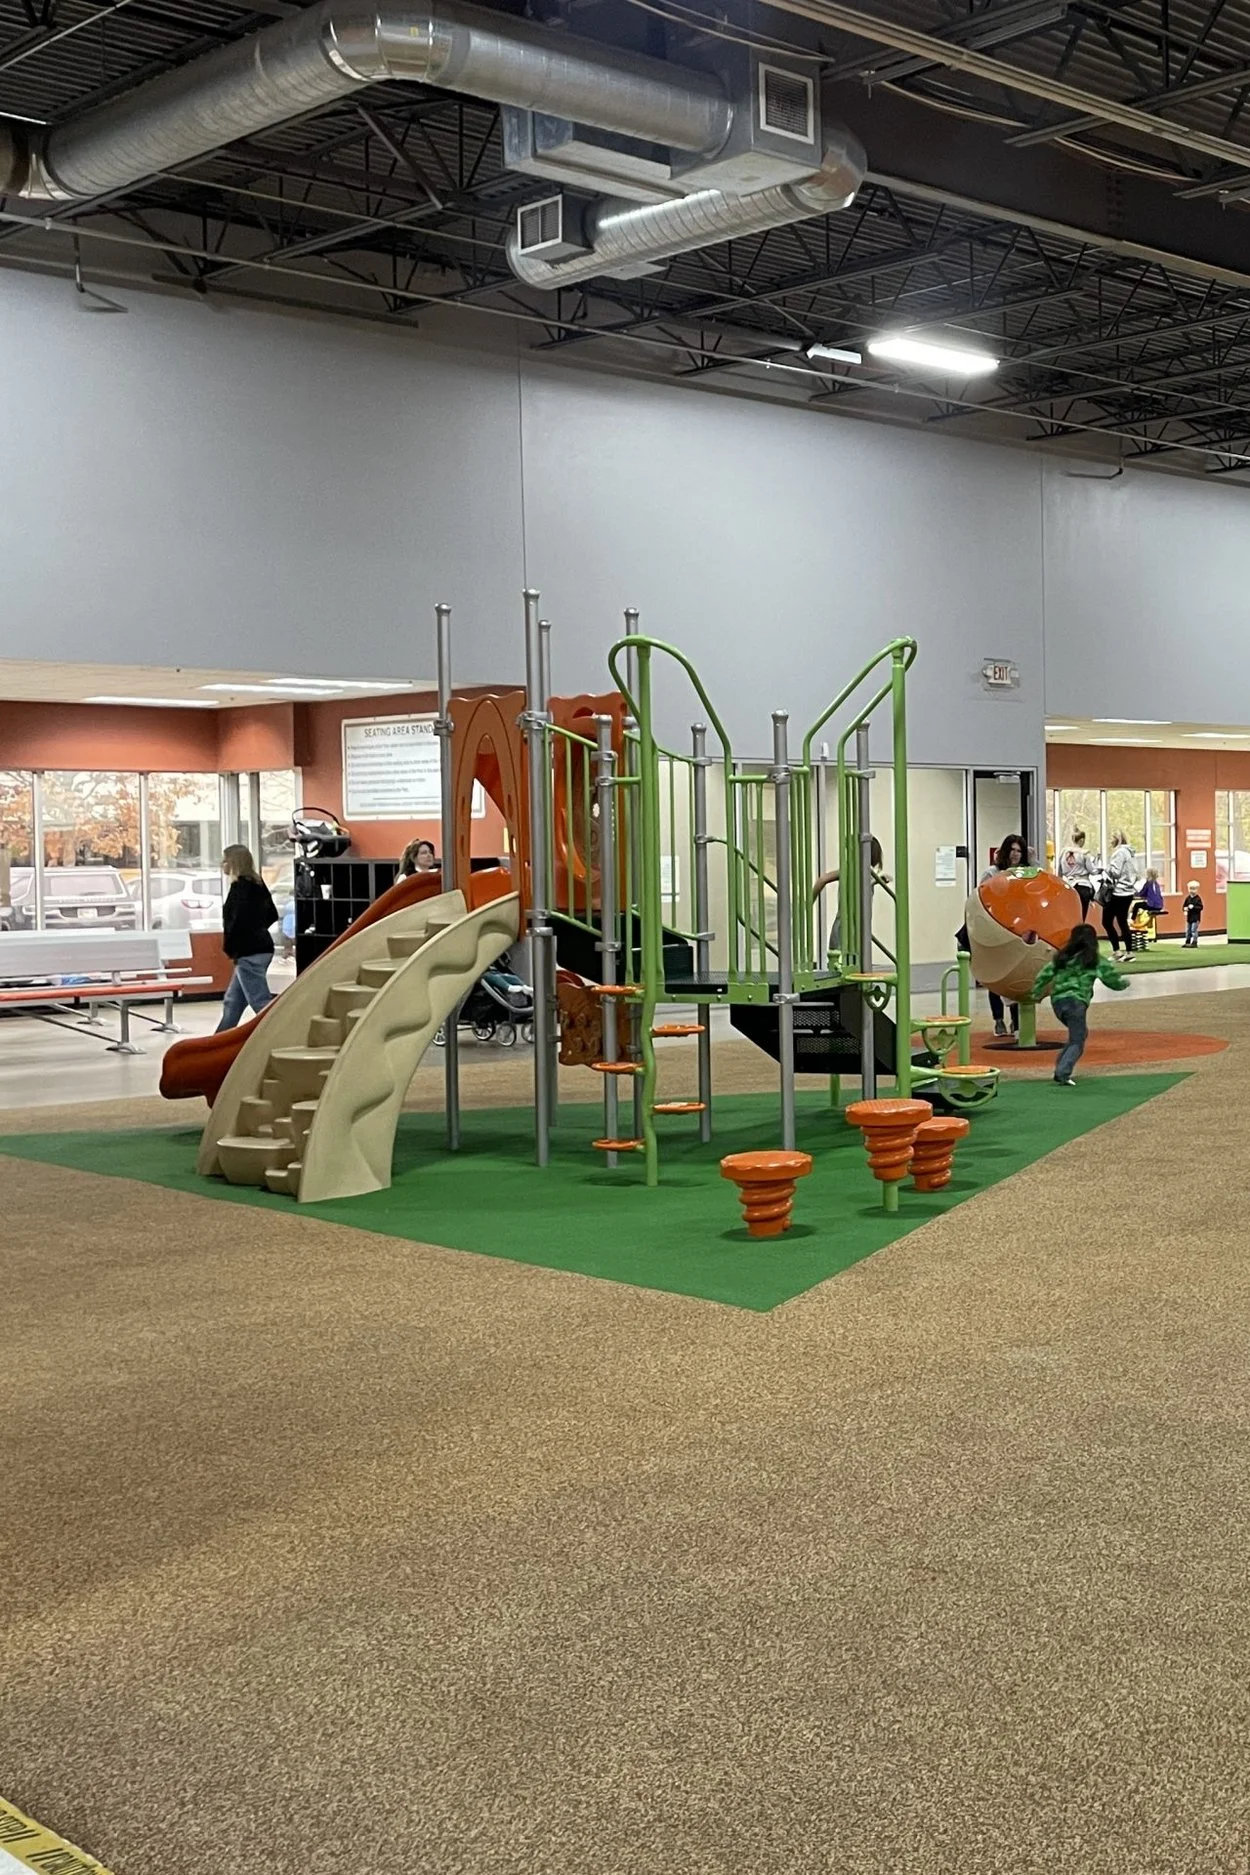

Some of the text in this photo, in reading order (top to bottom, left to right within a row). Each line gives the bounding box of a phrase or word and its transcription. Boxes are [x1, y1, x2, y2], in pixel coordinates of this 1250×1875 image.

[364, 723, 434, 738] SEATING AREA STAND
